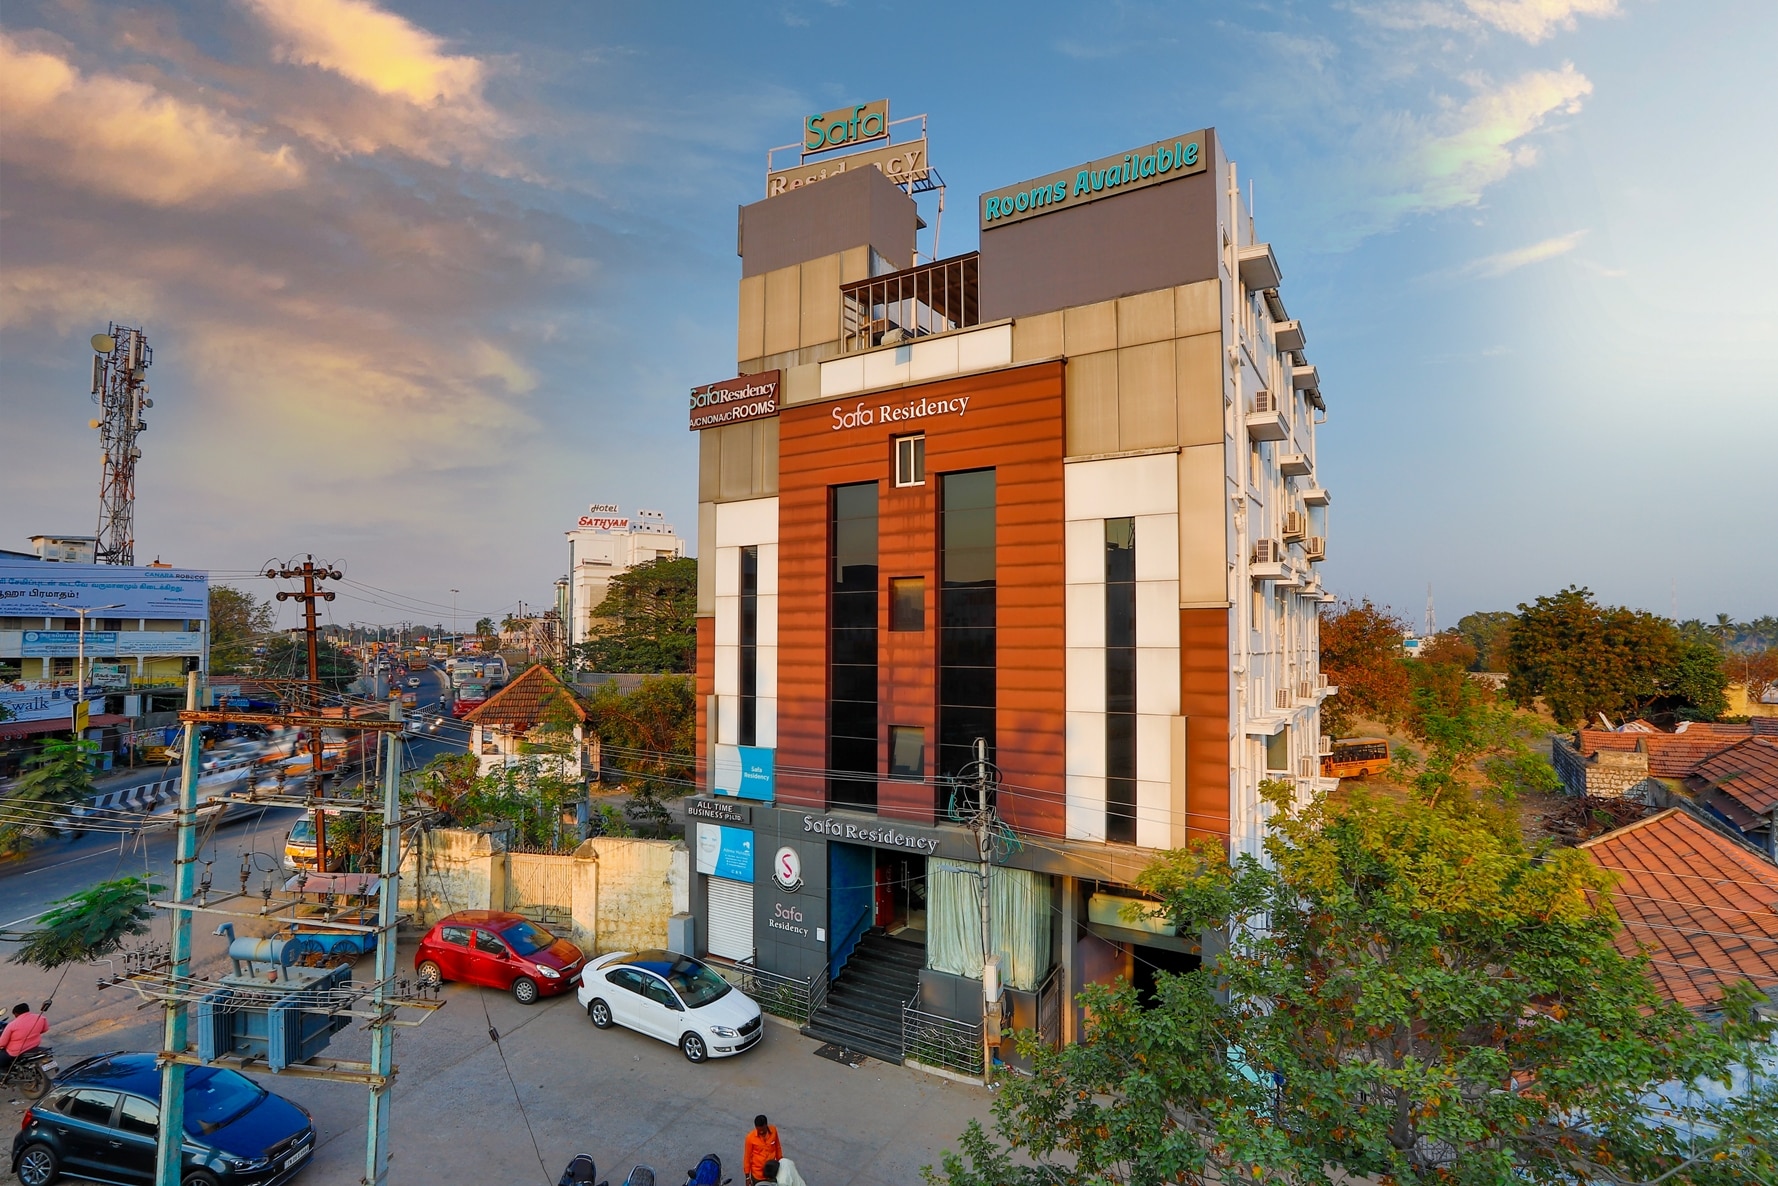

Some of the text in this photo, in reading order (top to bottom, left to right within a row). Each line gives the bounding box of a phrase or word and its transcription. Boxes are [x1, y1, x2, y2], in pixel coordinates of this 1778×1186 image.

[806, 104, 885, 150] Safa
[985, 141, 1199, 222] Rooms Available
[689, 382, 777, 410] Safa Residency
[732, 400, 775, 420] ROOMS
[832, 396, 970, 430] Safa Residency
[590, 504, 618, 513] Hotel
[144, 571, 174, 579] CANARA
[688, 807, 723, 819] BUSINESS
[696, 801, 733, 813] ALL TIME
[803, 814, 940, 855] Safa Residency
[774, 902, 803, 923] Safa
[768, 918, 809, 938] Residency
